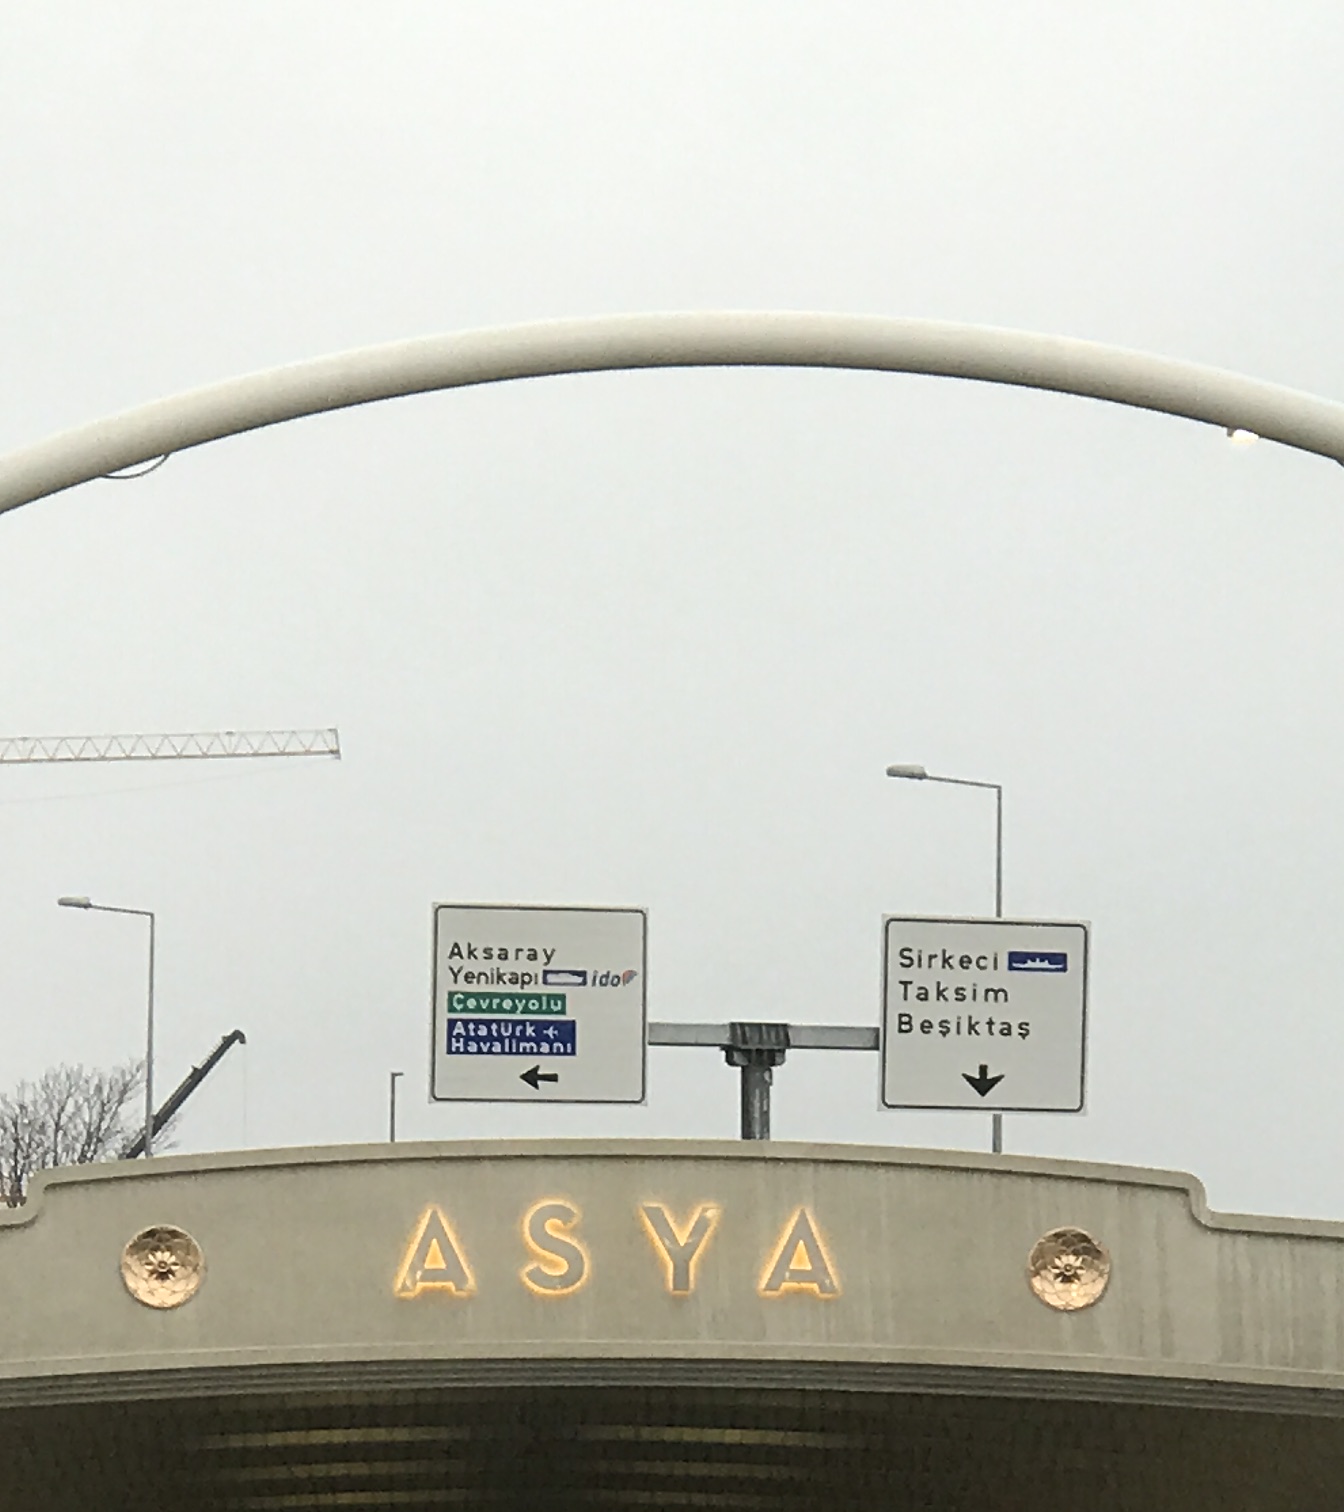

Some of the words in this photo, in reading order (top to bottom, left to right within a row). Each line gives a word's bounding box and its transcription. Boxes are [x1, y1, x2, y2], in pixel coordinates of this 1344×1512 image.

[448, 942, 556, 966] Aksaray
[899, 947, 998, 971] Sirkeci
[449, 965, 538, 989] Yenikapı
[452, 993, 562, 1013] Çevreyolu
[898, 980, 1009, 1003] Taksim
[452, 1021, 536, 1036] Atatürk
[897, 1013, 1031, 1040] Beşiktaş
[451, 1038, 572, 1054] Havalimanı
[394, 1200, 841, 1297] ASYA
